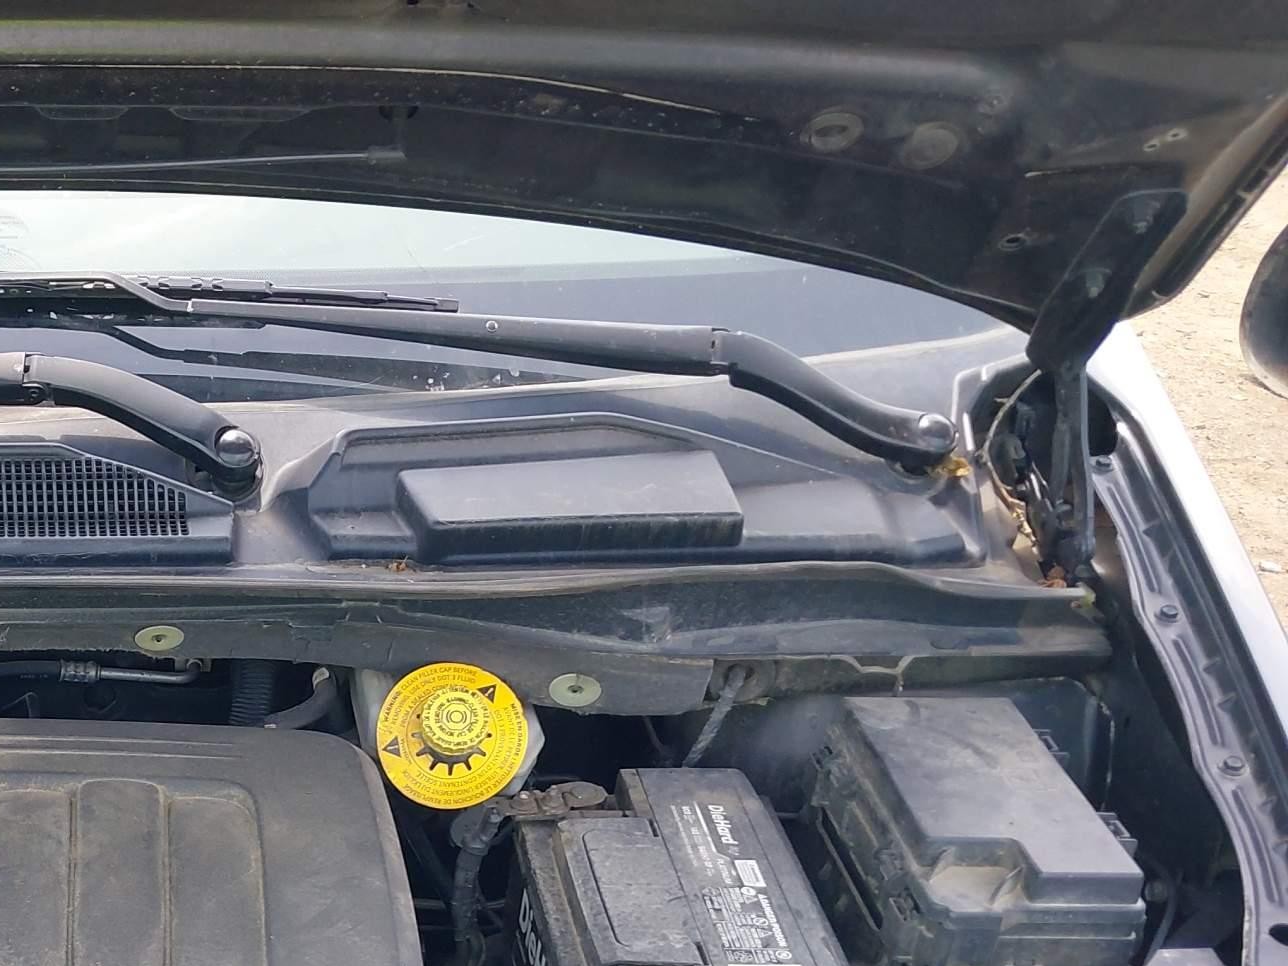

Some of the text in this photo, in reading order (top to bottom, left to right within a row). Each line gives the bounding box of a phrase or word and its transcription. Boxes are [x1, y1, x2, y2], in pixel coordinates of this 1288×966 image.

[417, 667, 437, 680] FILLER
[453, 666, 477, 676] BEFORE
[453, 789, 485, 804] BOUCHON
[708, 804, 739, 845] DieHard
